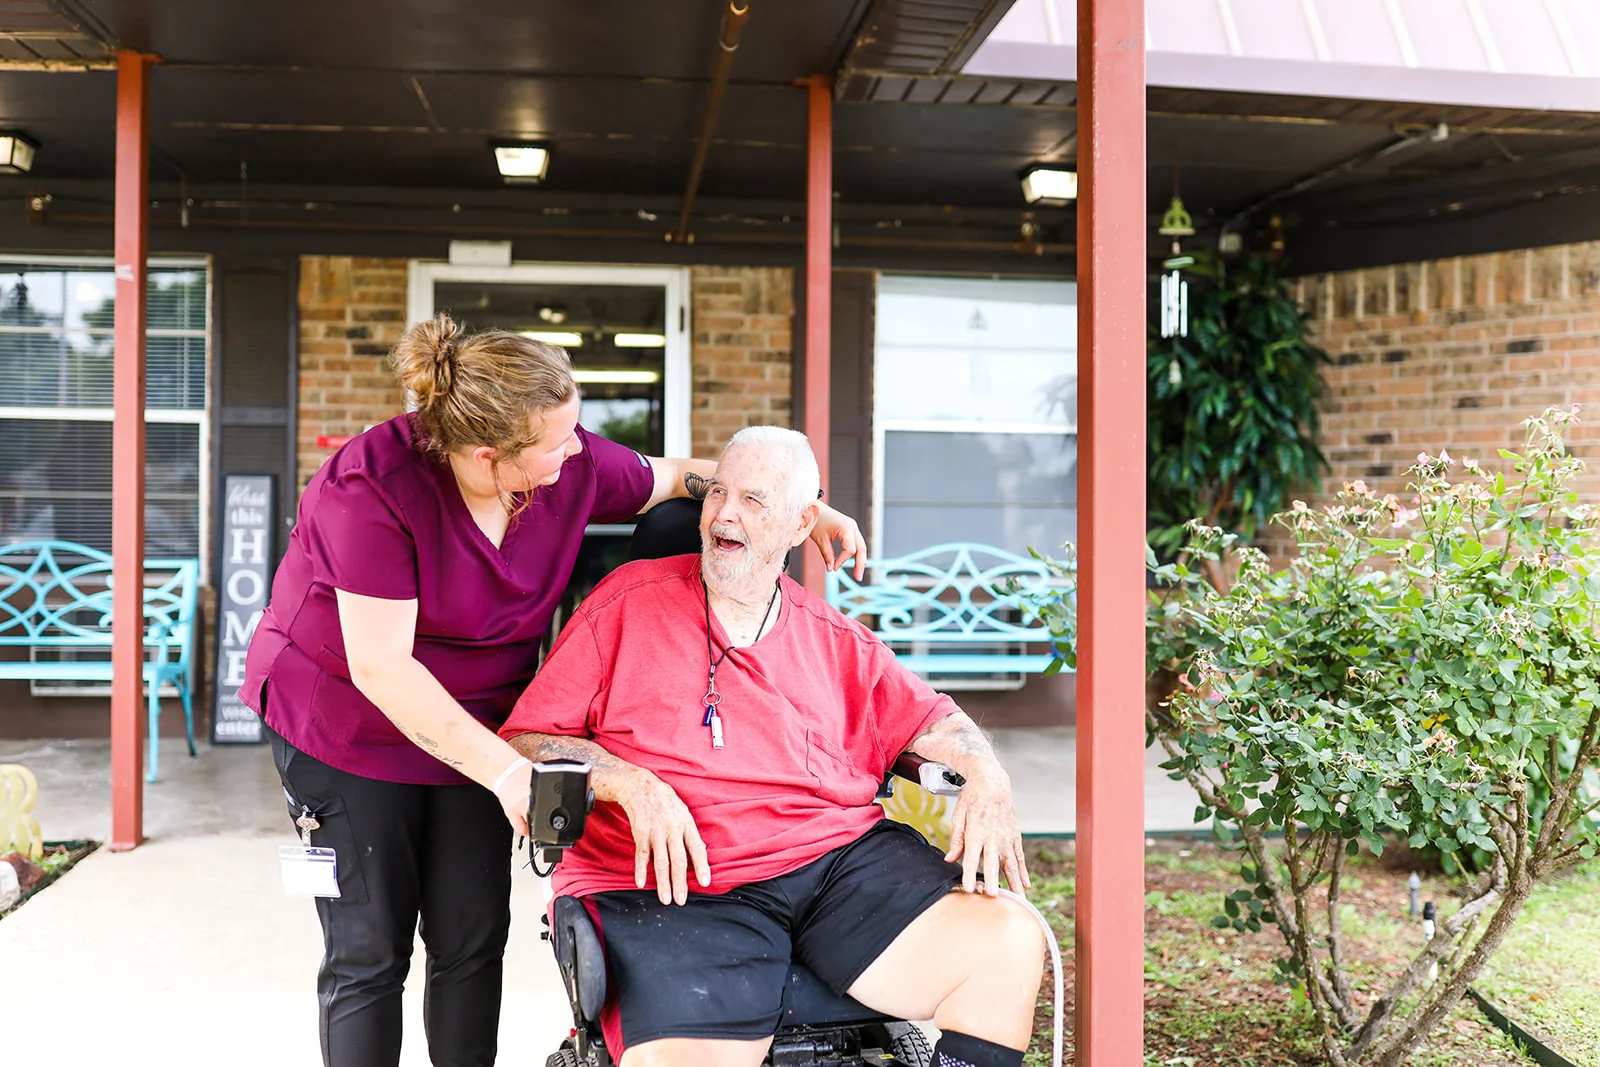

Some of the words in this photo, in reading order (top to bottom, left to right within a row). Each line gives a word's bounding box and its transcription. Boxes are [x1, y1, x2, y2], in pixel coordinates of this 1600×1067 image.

[231, 507, 263, 525] this
[222, 528, 267, 687] HOME
[216, 721, 261, 735] enter
